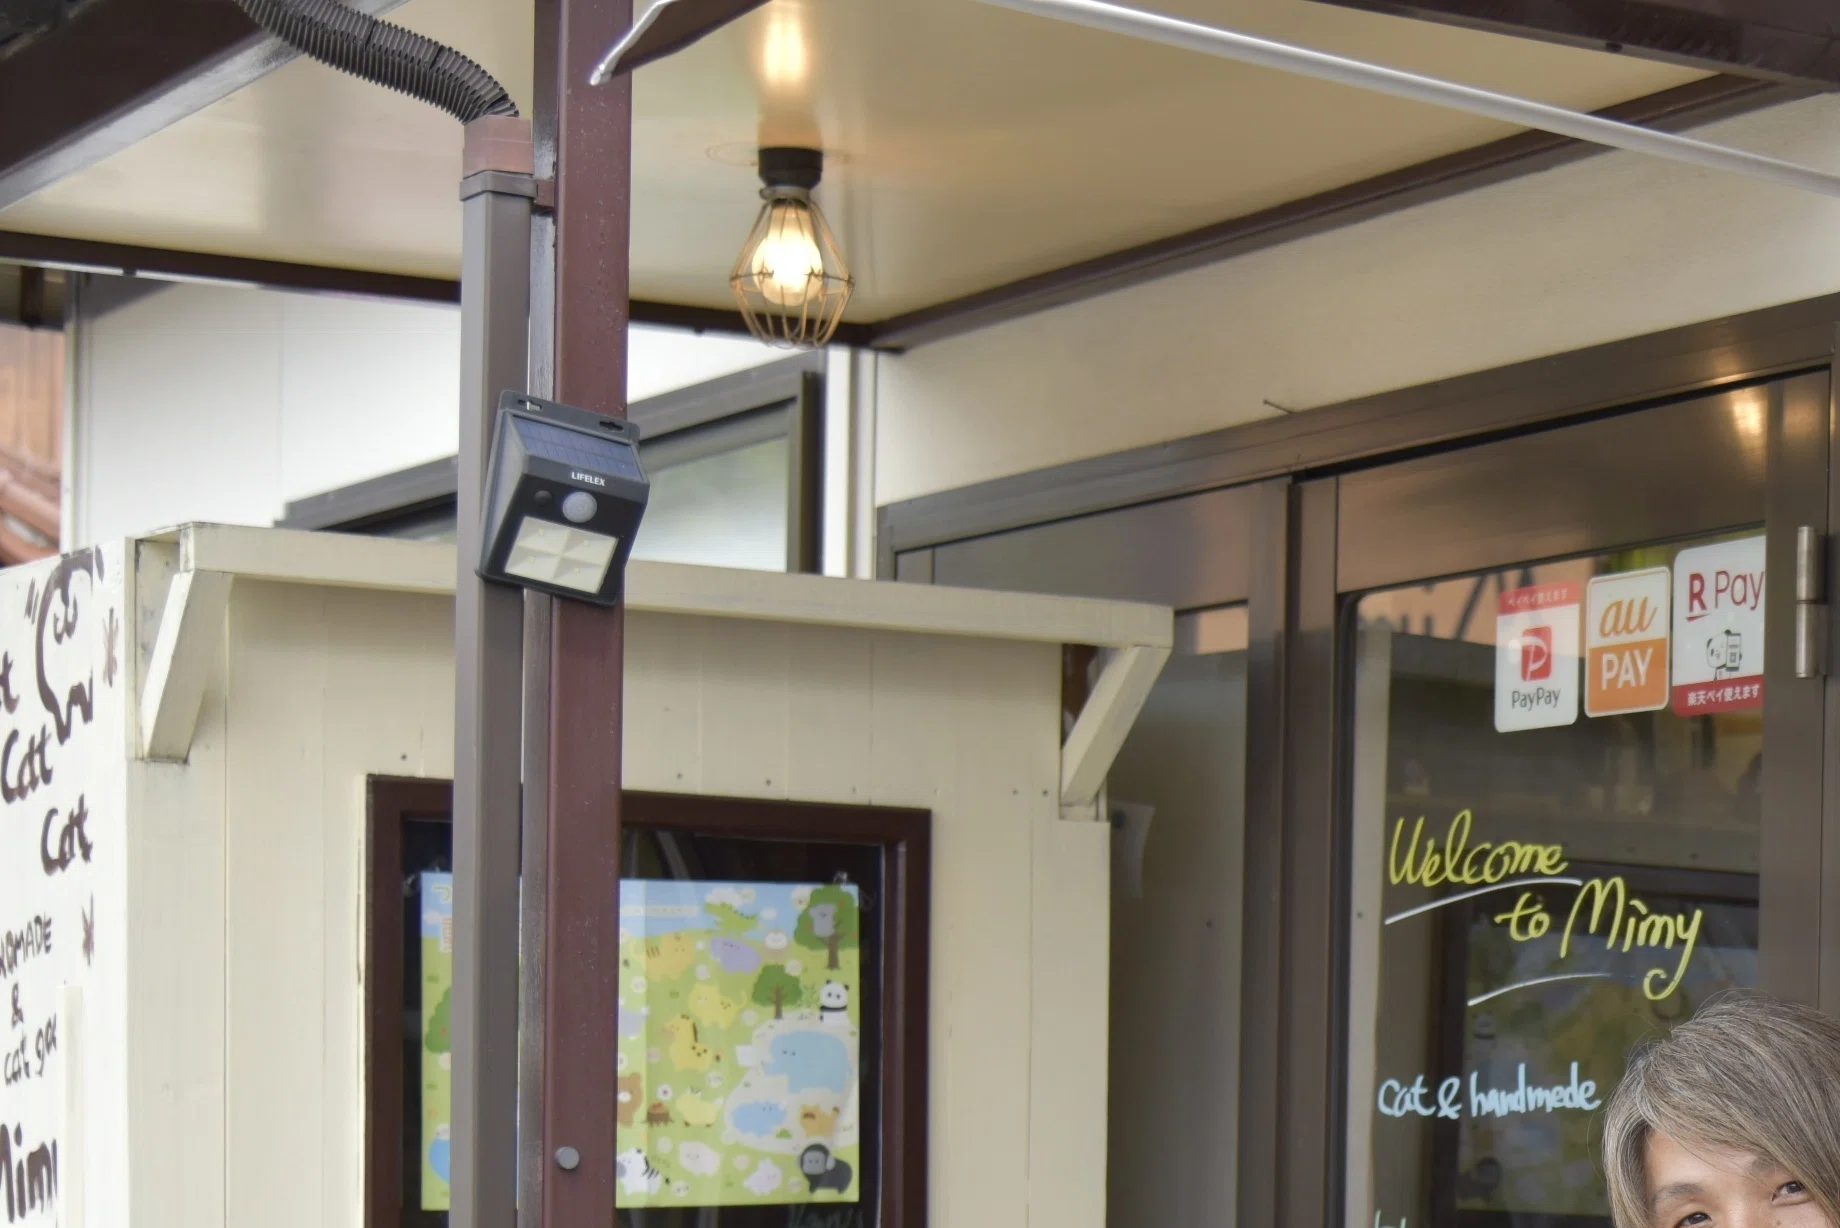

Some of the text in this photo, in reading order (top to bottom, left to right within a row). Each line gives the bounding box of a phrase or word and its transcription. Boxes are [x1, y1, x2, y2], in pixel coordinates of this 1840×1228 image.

[571, 471, 606, 487] LIFELEX
[1714, 570, 1765, 611] Pay
[1599, 596, 1657, 639] au
[1601, 648, 1654, 691] PAY
[1511, 687, 1561, 712] PayPay
[1687, 682, 1761, 708] 楽天ペイ使えます
[40, 792, 93, 877] Cat
[1389, 809, 1568, 888] Welcome
[1494, 876, 1703, 1000] to Mimy
